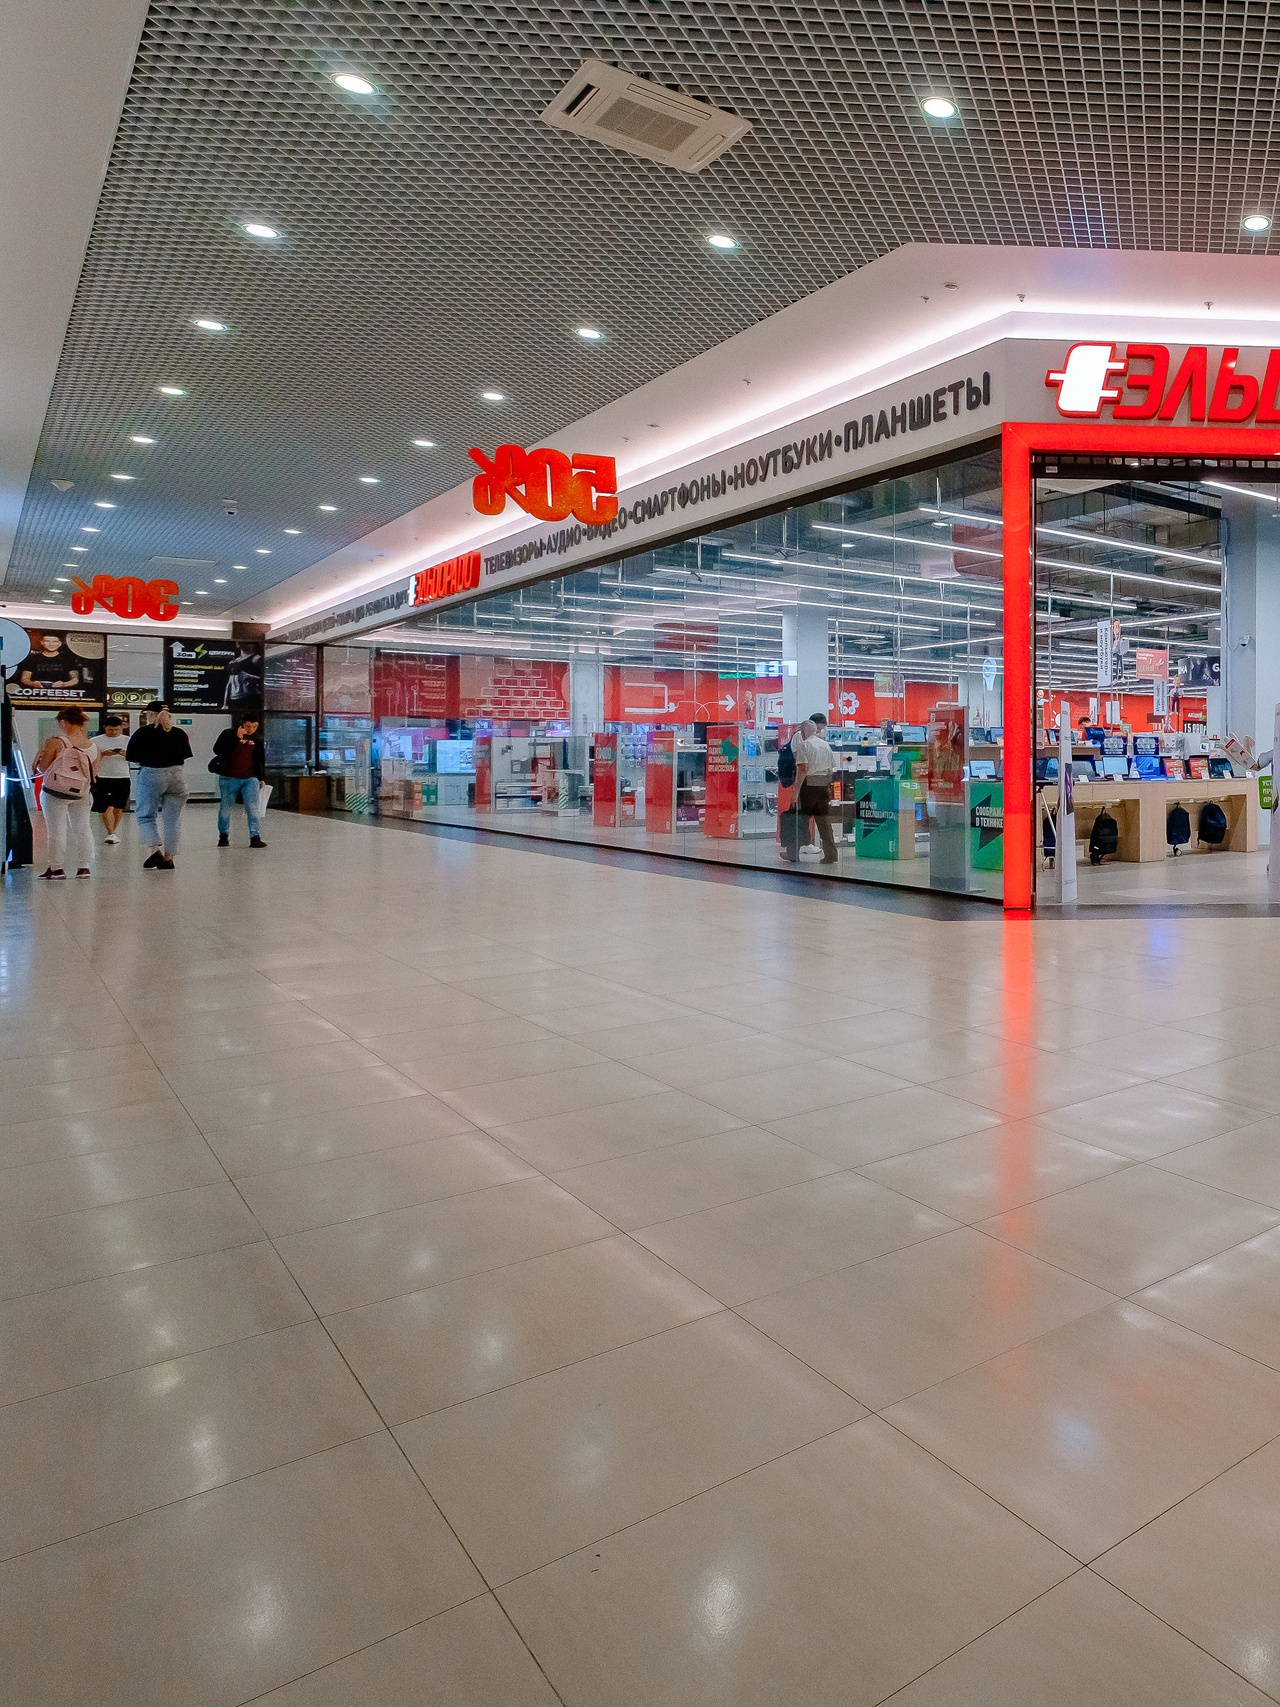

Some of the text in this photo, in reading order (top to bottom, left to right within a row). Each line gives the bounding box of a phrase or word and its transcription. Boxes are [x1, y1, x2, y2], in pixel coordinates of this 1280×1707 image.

[484, 538, 543, 575] ТЕЛЕВИЗОРЫ
[546, 524, 581, 555] АУДИО
[632, 470, 726, 525] СМАРТФОНЫ
[733, 435, 833, 491] НОУТБУКИ
[843, 371, 991, 453] ПЛАНШЕТЫ
[16, 688, 86, 697] COFFEESET
